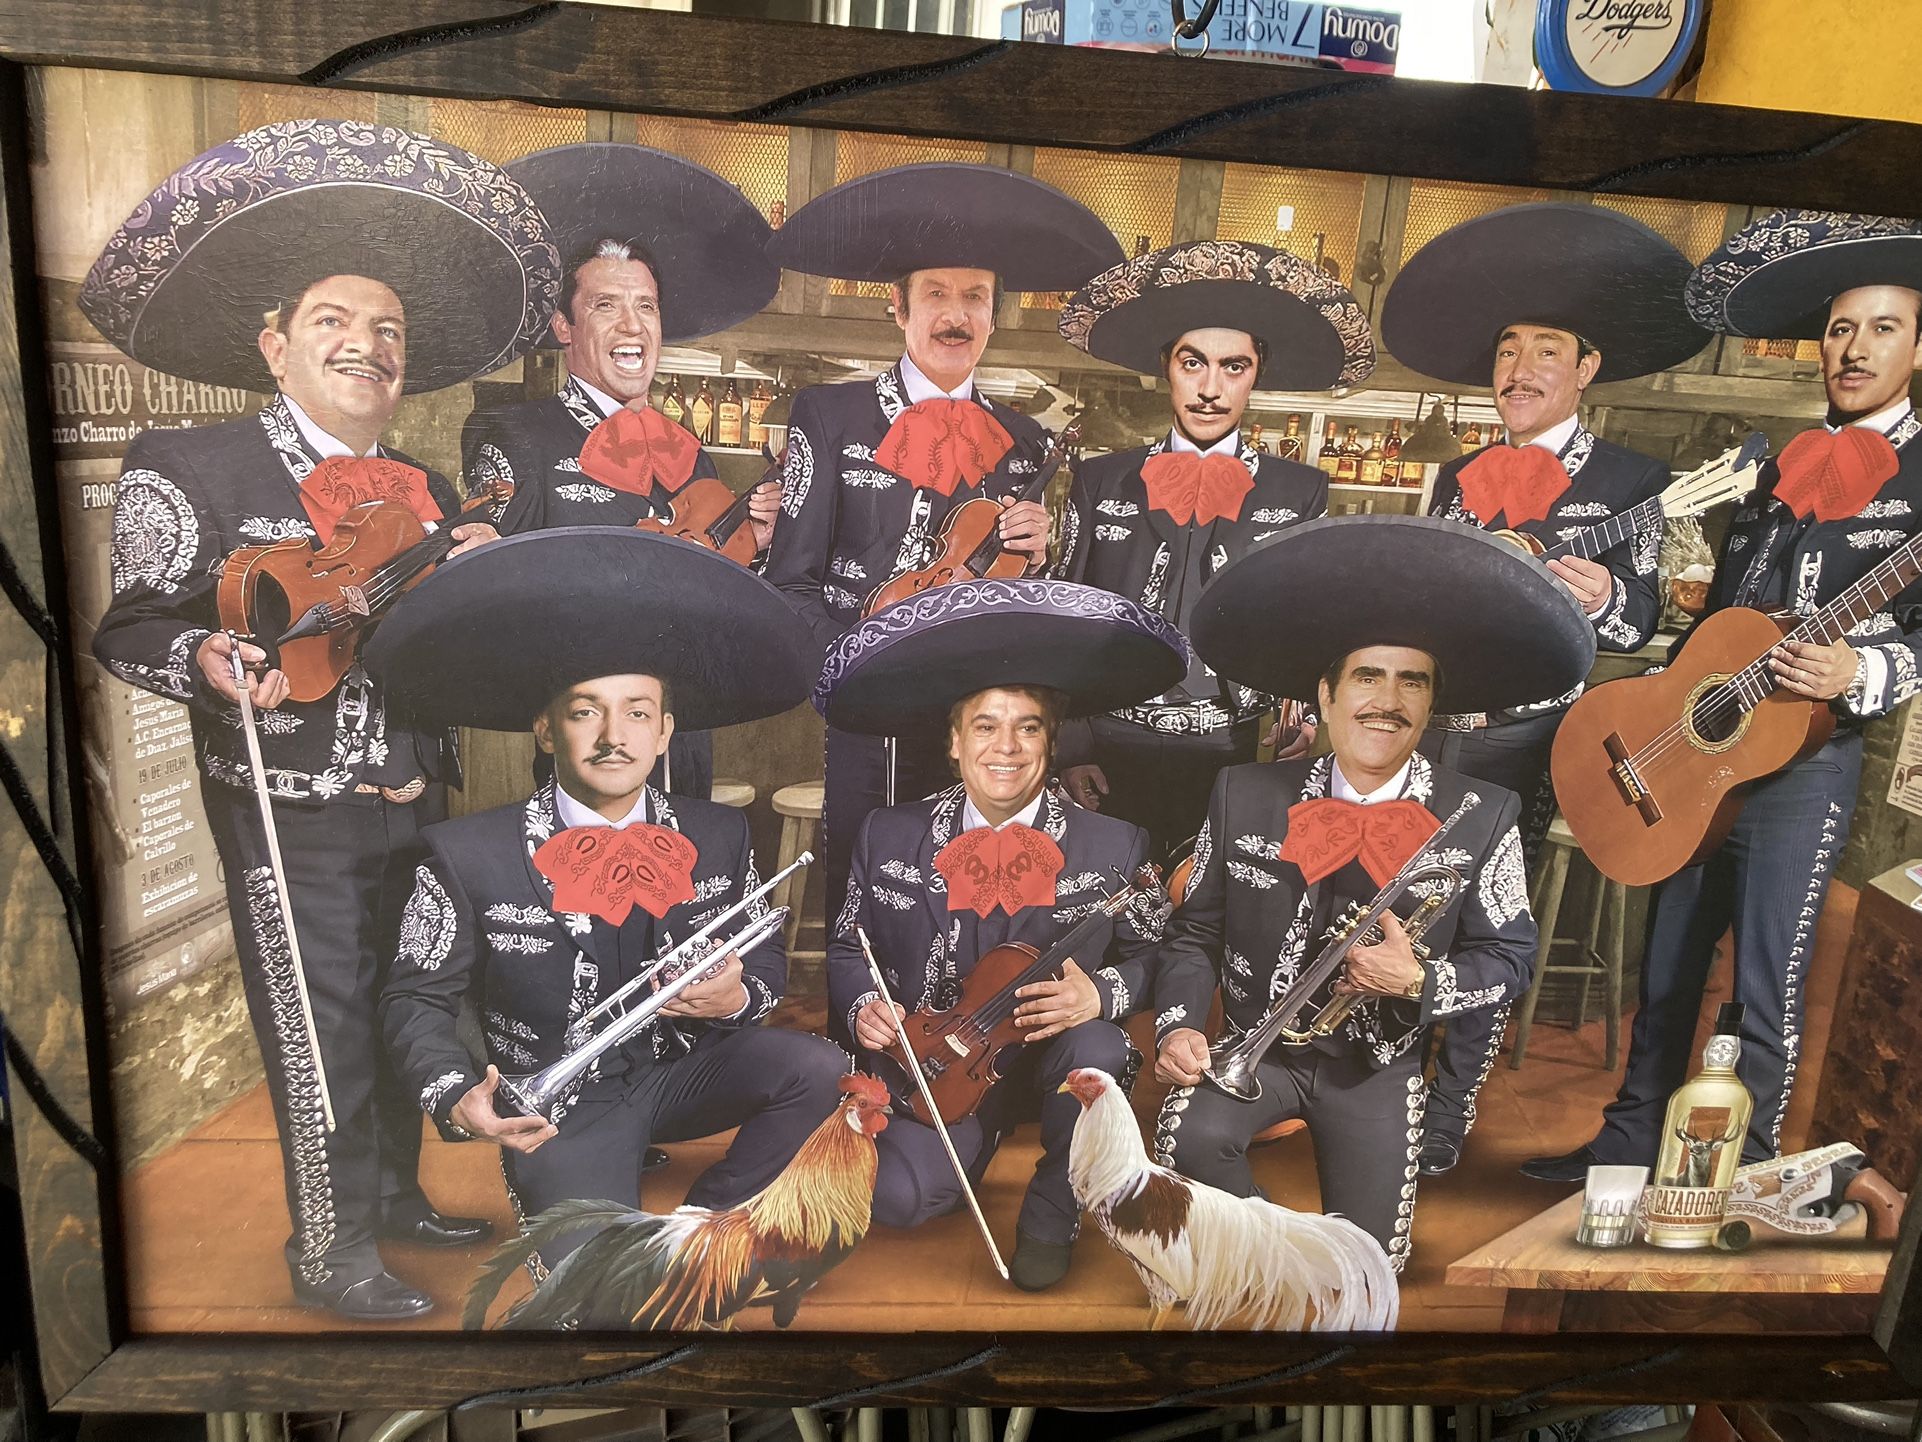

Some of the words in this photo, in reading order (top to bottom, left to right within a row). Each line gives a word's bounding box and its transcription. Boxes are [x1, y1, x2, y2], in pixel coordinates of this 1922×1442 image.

[1024, 7, 1060, 36] Downy
[1220, 18, 1288, 45] MORE
[1291, 3, 1315, 49] 7
[1323, 6, 1400, 51] Downy
[1575, 0, 1673, 40] Dodgers
[80, 420, 126, 443] Charro
[135, 747, 146, 759] de
[138, 768, 147, 784] 19
[150, 763, 161, 780] DE
[164, 754, 187, 775] JULIO
[181, 778, 192, 790] de
[184, 818, 195, 831] de
[140, 873, 147, 887] 3
[150, 867, 161, 884] DE
[163, 853, 194, 878] AGOSTO
[1654, 1188, 1728, 1216] CAZADORES
